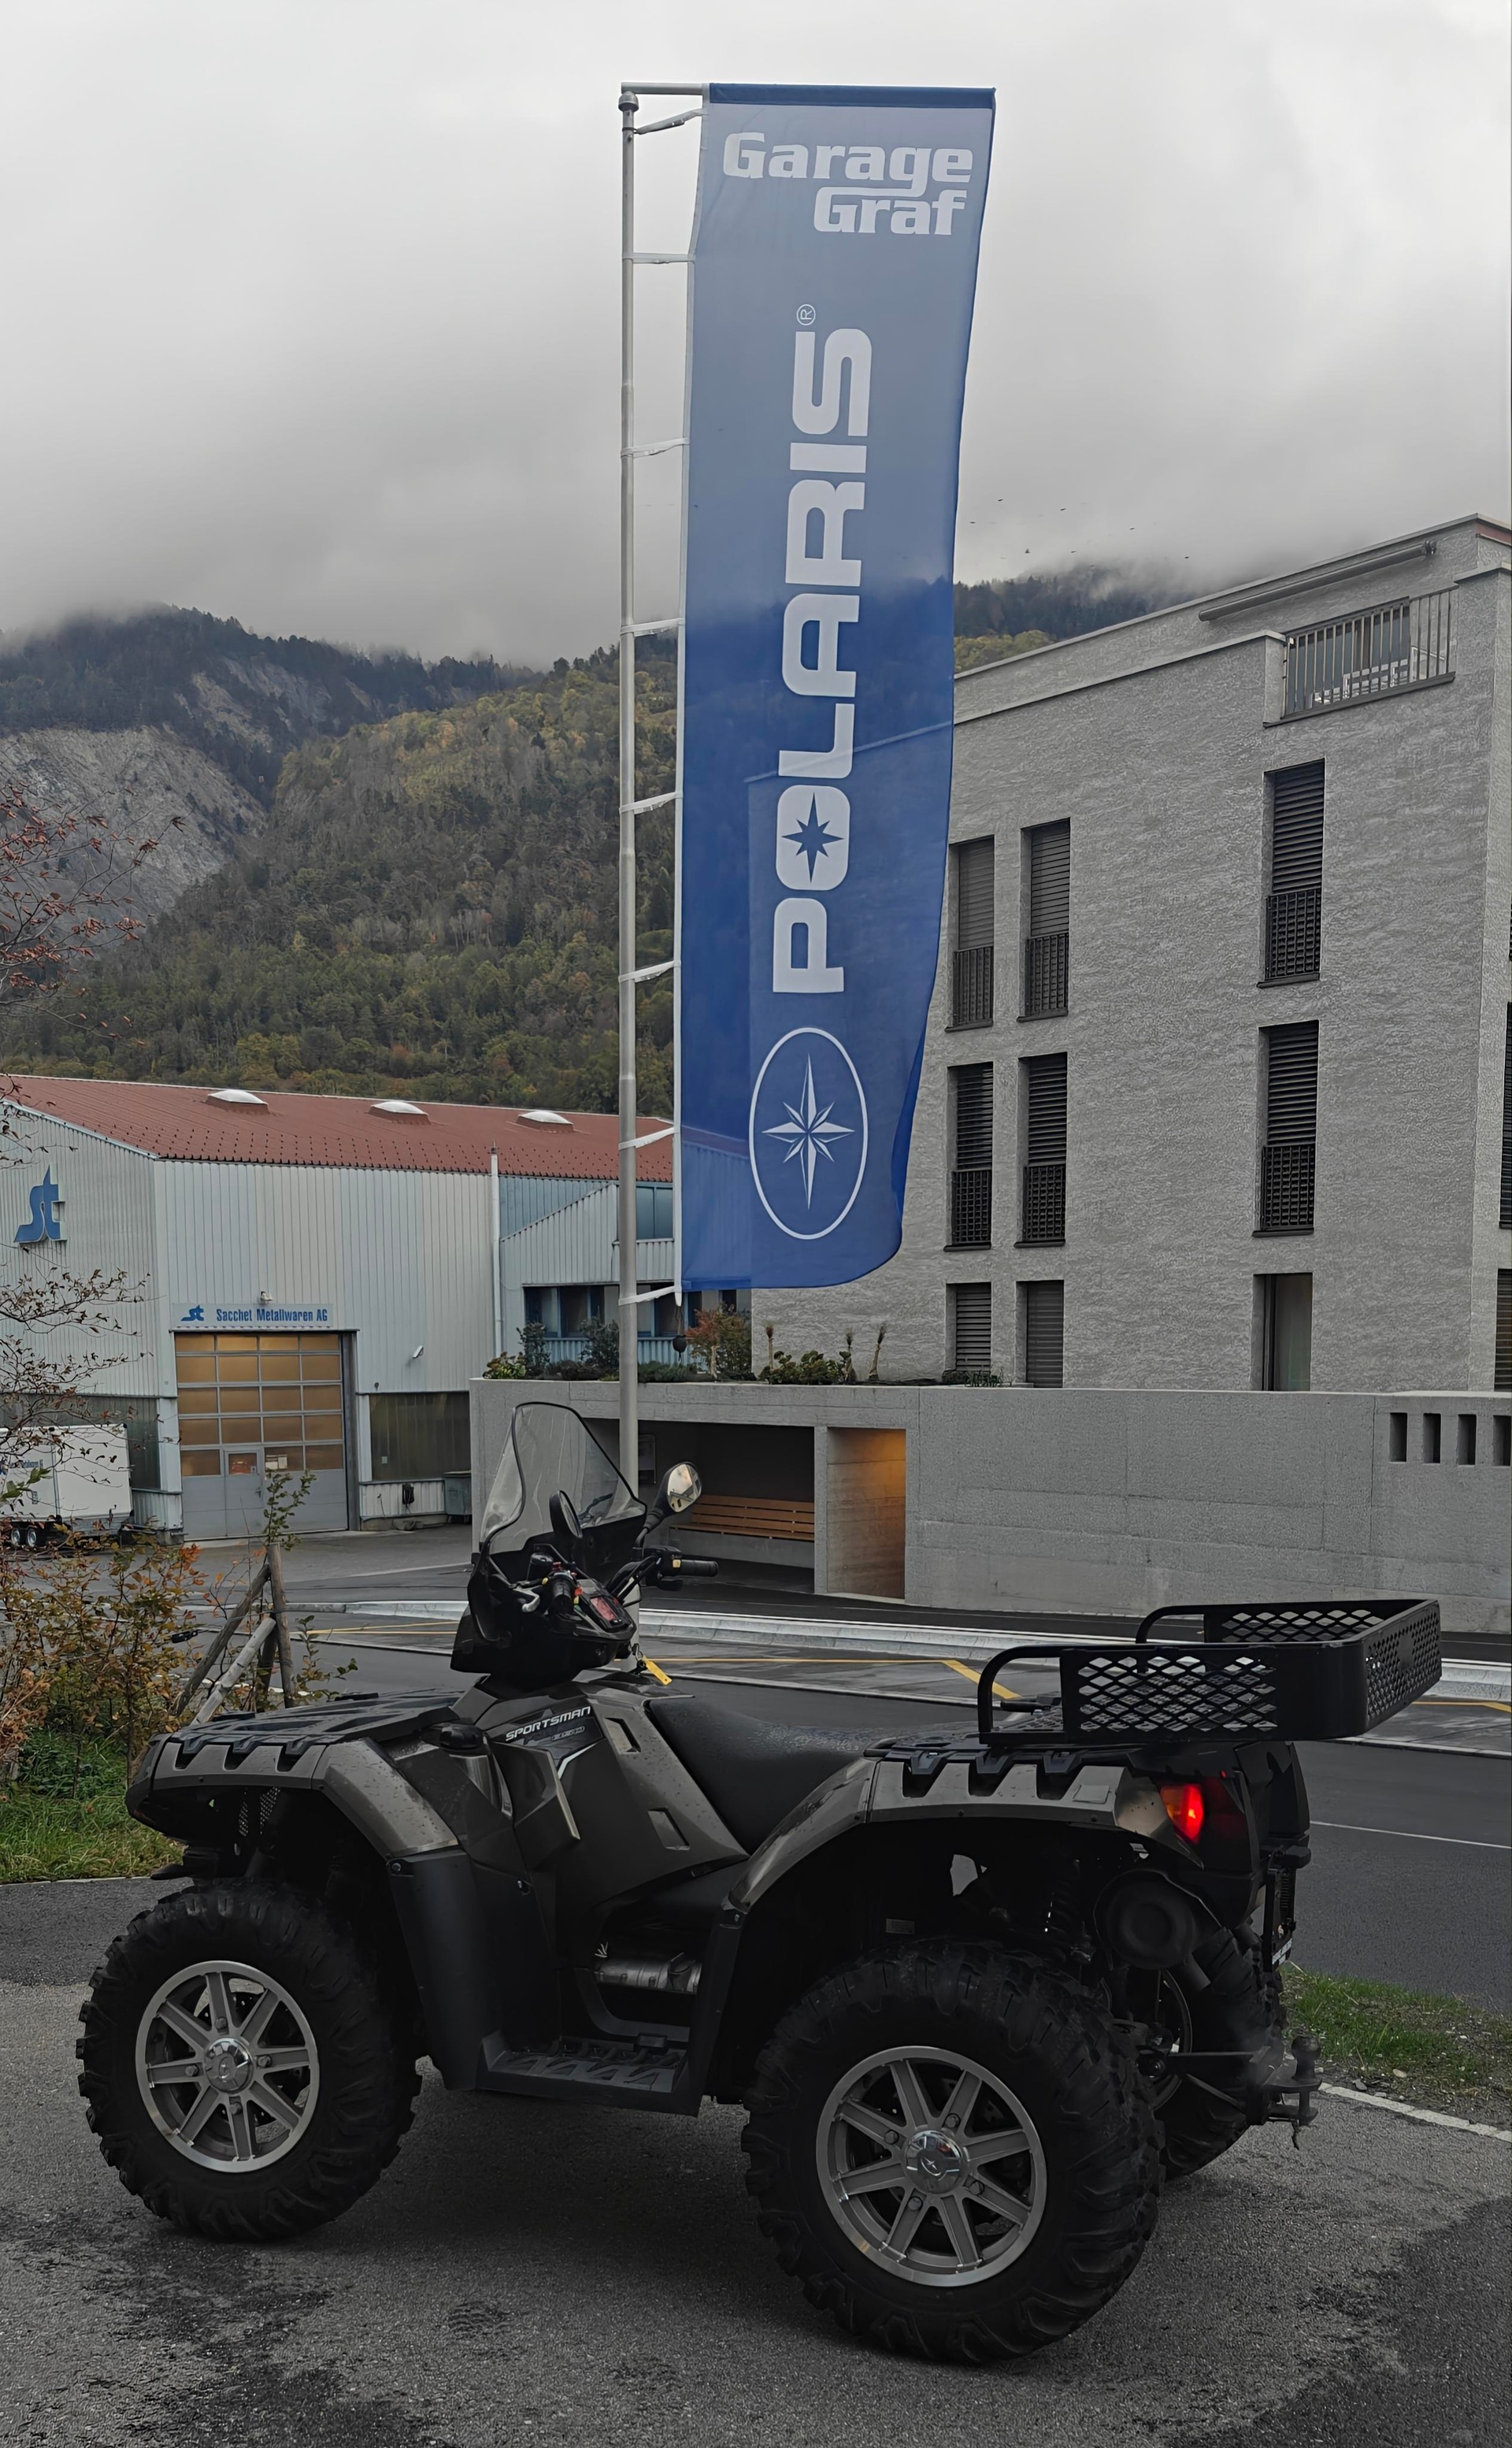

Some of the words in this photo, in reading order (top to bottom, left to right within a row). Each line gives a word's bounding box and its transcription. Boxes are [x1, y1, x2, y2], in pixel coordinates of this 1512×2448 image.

[723, 132, 973, 197] Garage
[813, 187, 967, 236] Graf
[216, 1308, 252, 1322] Sacchet
[256, 1308, 313, 1322] Metallwaren
[316, 1308, 328, 1322] AG
[506, 1705, 591, 1741] SPORTSMAN
